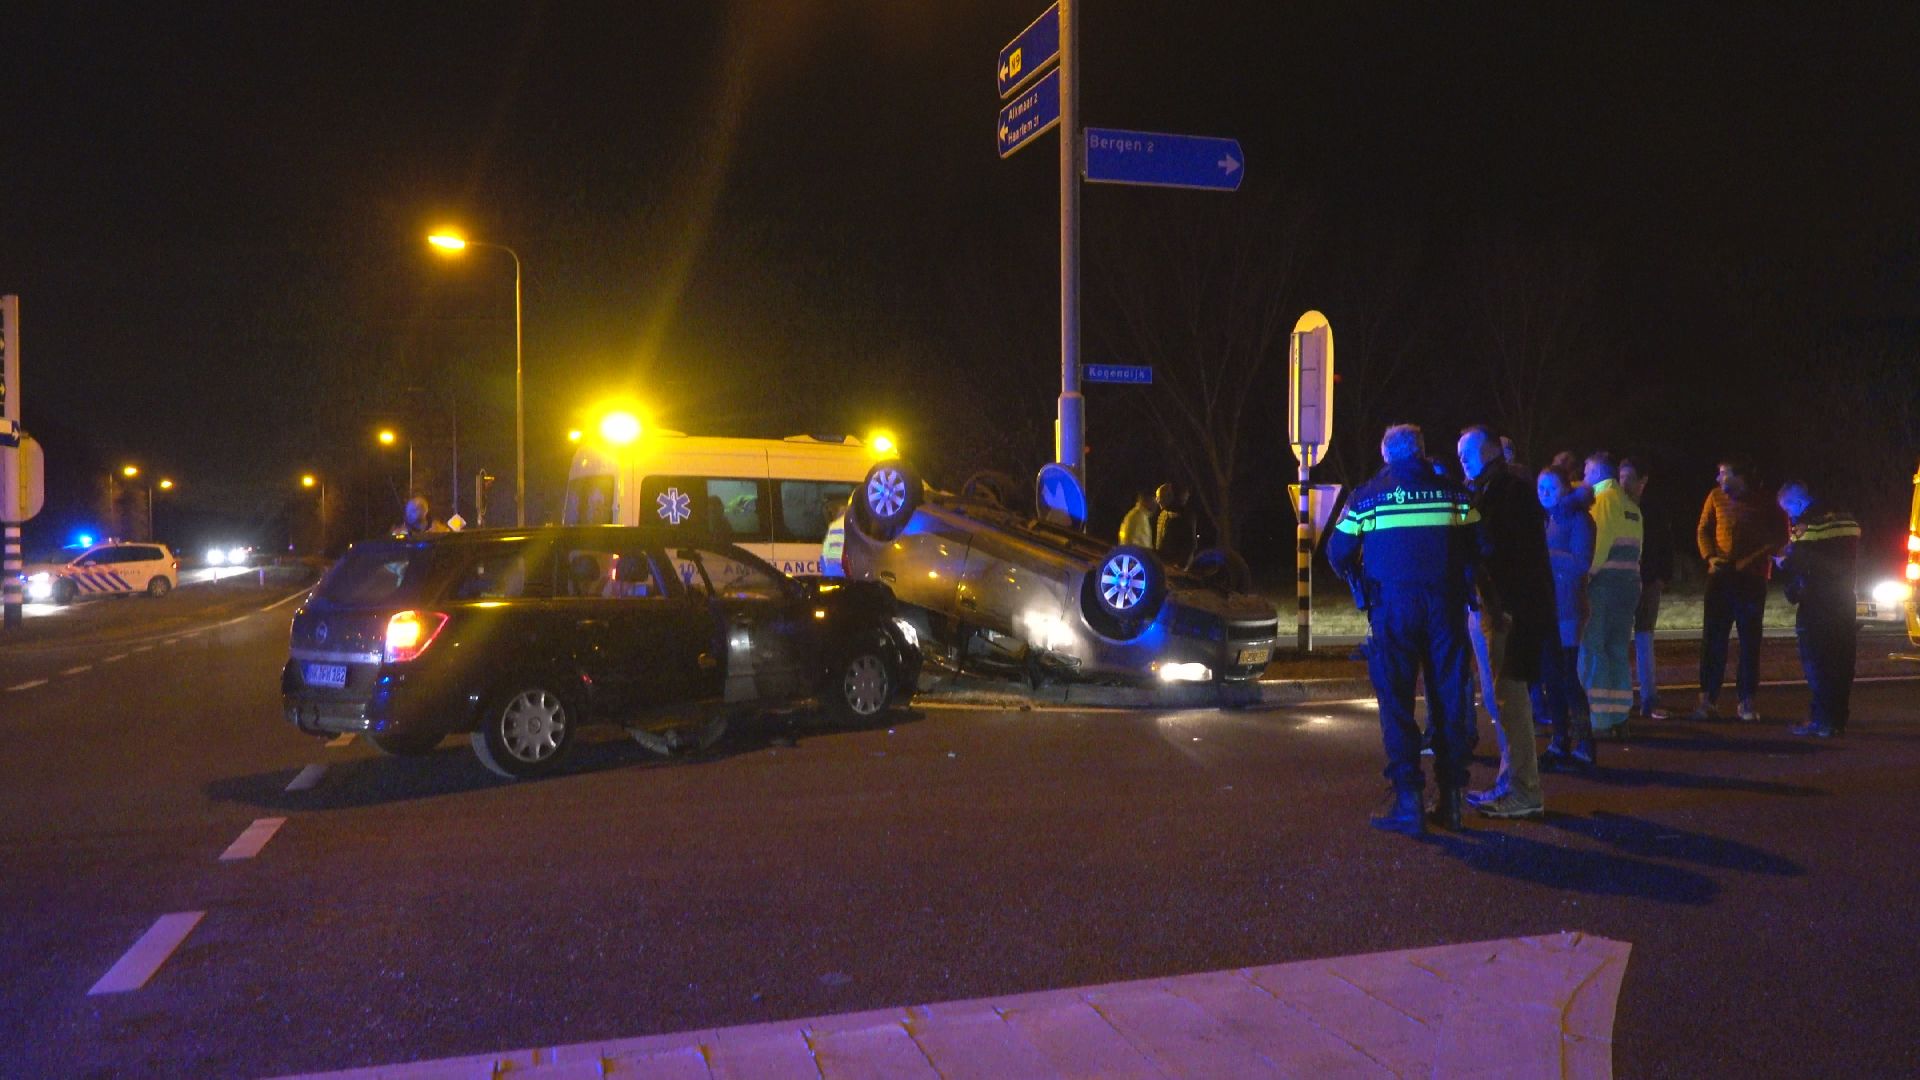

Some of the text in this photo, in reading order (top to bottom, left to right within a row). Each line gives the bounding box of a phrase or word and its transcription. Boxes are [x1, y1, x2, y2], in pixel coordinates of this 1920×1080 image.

[1008, 96, 1033, 122] Alkmaar
[1008, 120, 1033, 144] Haarlem
[1089, 134, 1154, 153] Bergen 2
